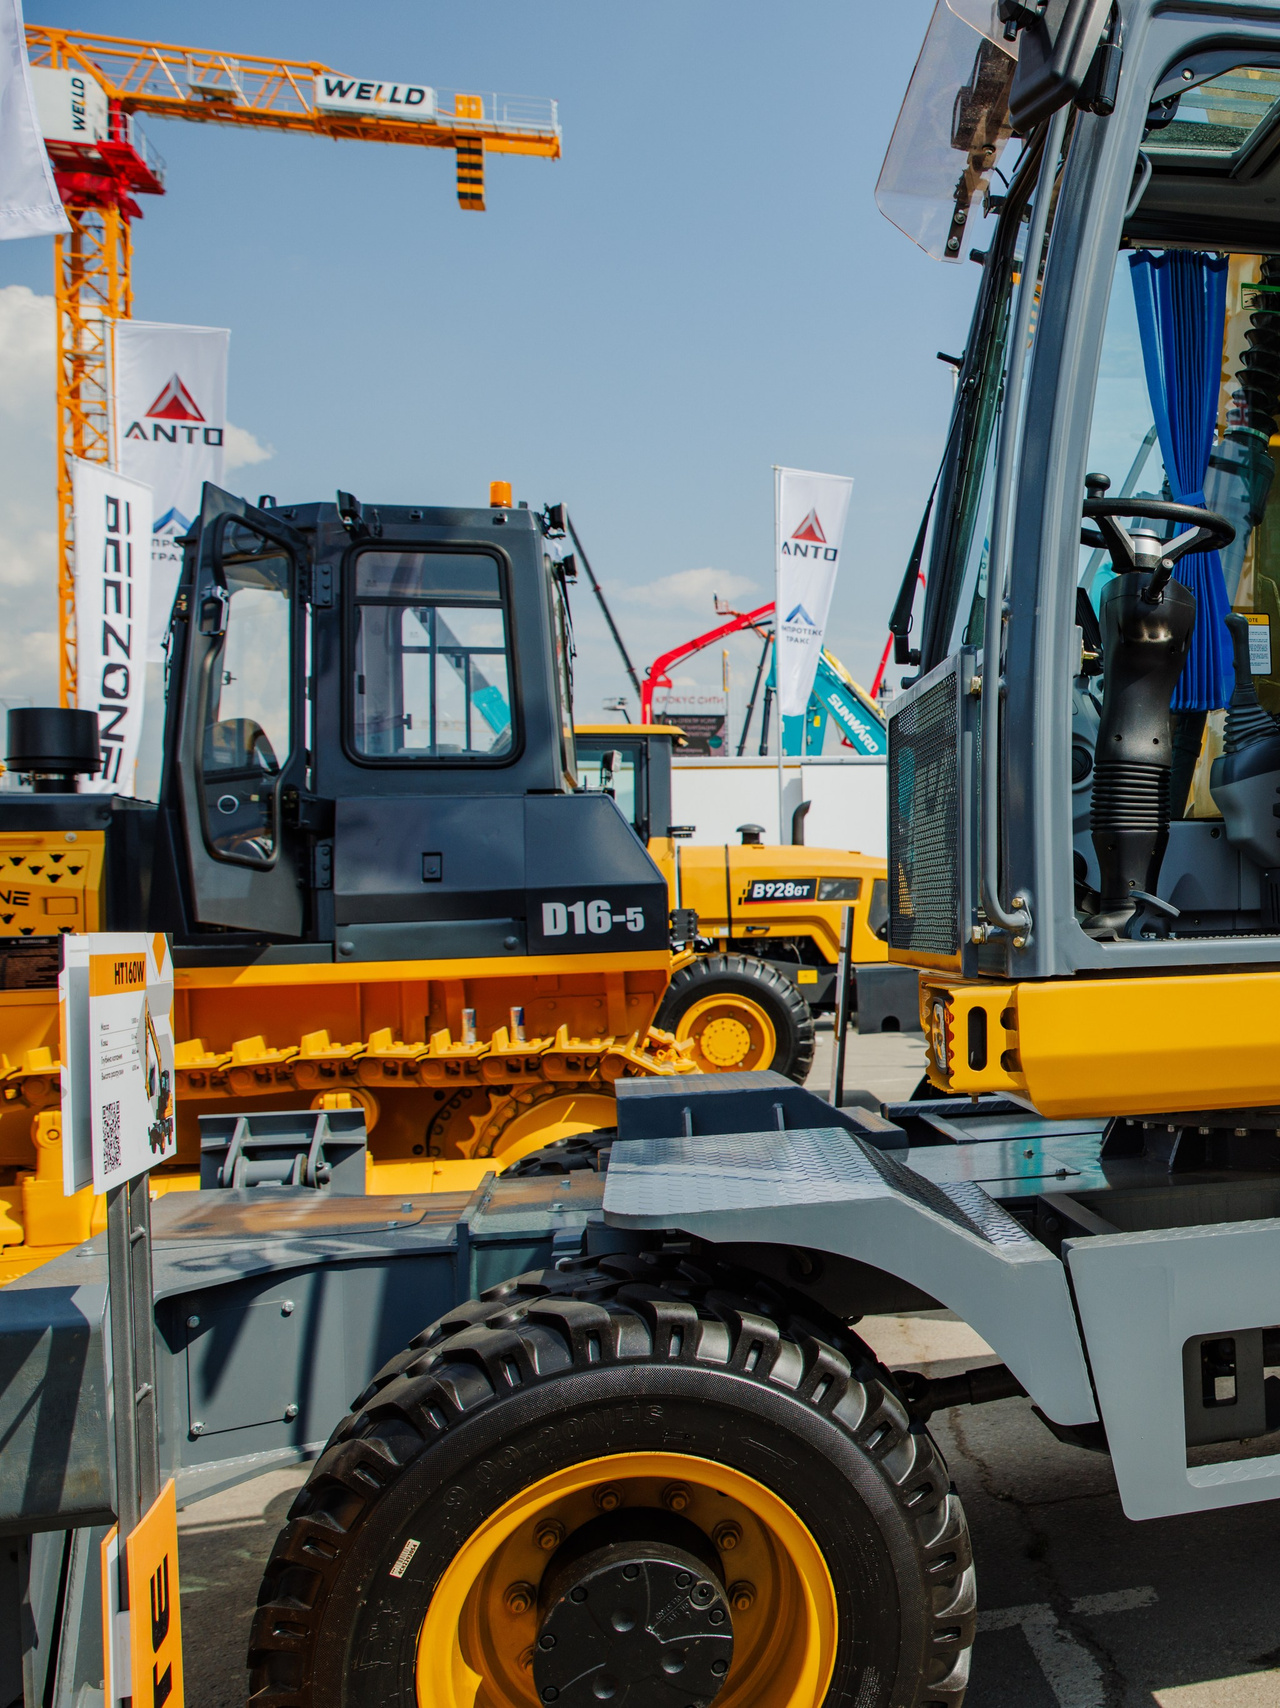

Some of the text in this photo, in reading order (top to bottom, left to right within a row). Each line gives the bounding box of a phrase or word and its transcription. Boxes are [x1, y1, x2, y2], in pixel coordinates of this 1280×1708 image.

[71, 77, 85, 131] WELLD
[324, 78, 426, 106] WELLD
[124, 421, 224, 447] ANTO
[781, 541, 838, 562] ANTO
[827, 693, 879, 753] SUNWARD
[753, 882, 811, 898] B928GT
[542, 900, 645, 936] D16-5
[114, 961, 145, 985] HT160W
